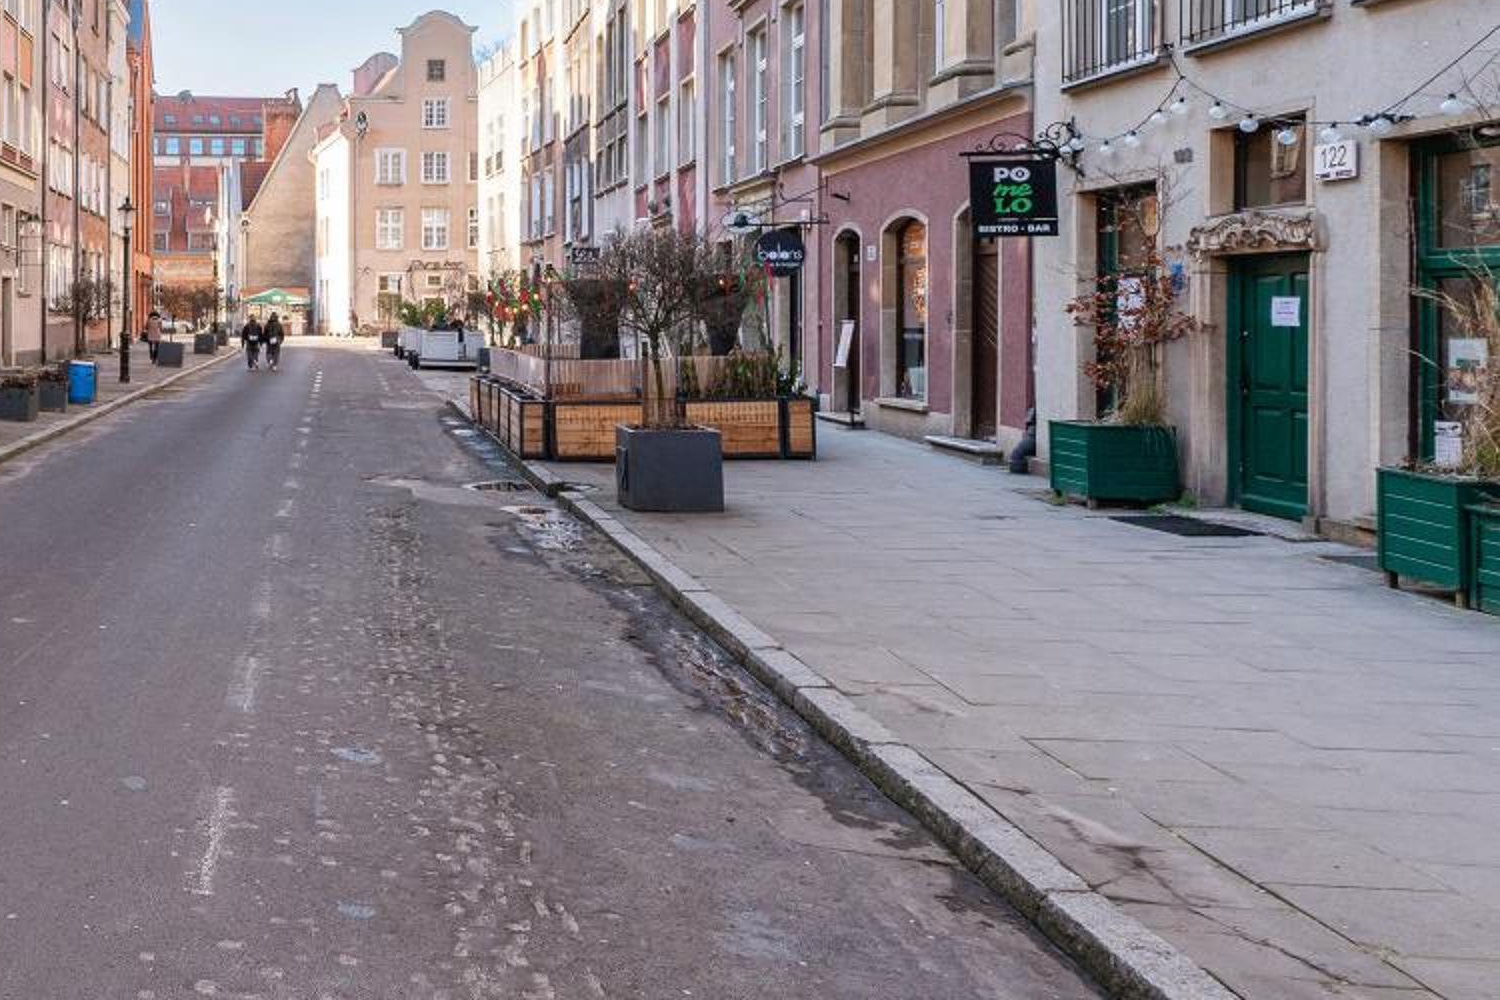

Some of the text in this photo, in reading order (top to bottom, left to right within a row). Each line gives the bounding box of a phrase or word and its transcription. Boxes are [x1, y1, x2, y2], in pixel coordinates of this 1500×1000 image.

[1321, 144, 1347, 168] 122
[993, 166, 1031, 182] PO
[993, 183, 1033, 197] me
[994, 197, 1033, 213] LO
[1027, 223, 1051, 232] BAR
